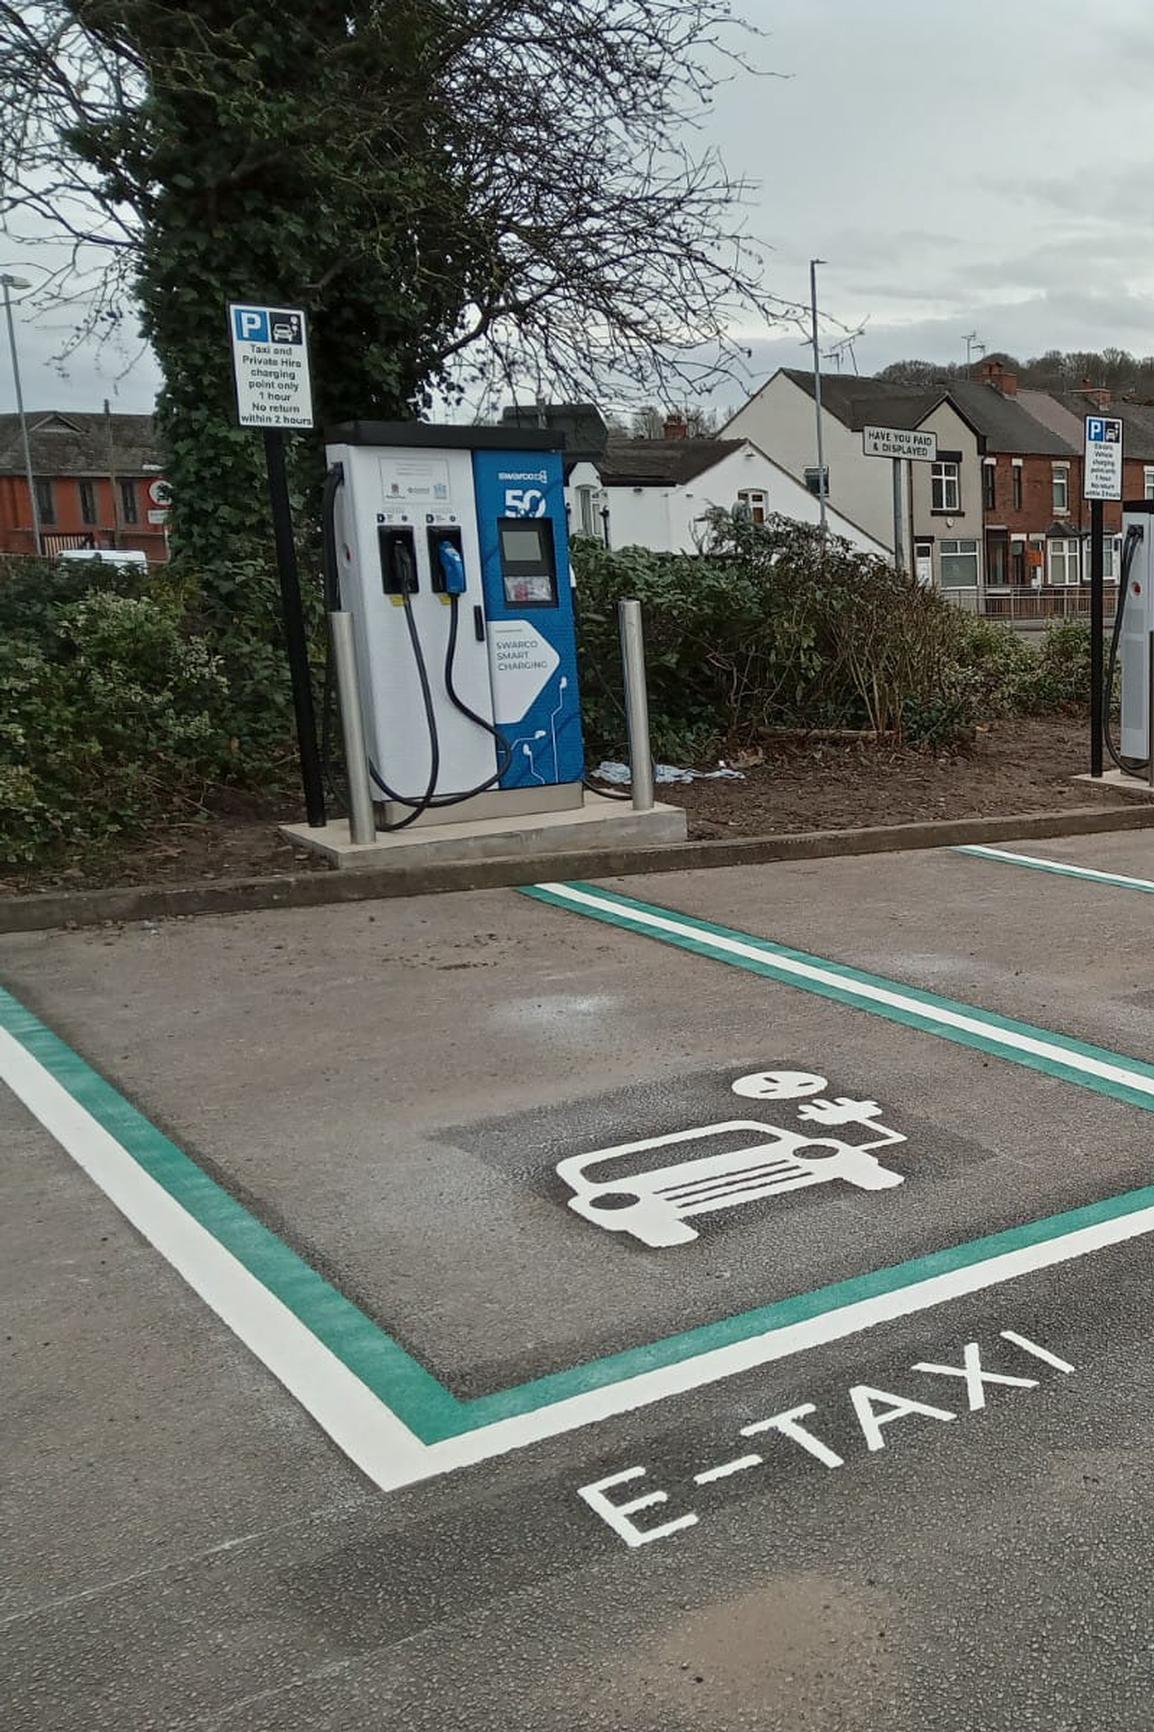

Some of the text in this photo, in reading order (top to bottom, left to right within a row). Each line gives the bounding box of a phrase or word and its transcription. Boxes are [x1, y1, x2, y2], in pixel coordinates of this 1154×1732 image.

[241, 311, 261, 338] P
[250, 344, 292, 356] Taxi and
[242, 355, 302, 368] Private Hire
[250, 368, 296, 381] charging
[248, 380, 299, 393] point only
[259, 391, 292, 402] 1 hour
[252, 403, 300, 413] No return
[241, 414, 312, 426] within 2 hours
[1091, 421, 1101, 440] P
[868, 430, 932, 446] HAVE YOU PAID
[873, 442, 928, 456] & DISPLAYED
[505, 489, 546, 518] 50
[496, 640, 538, 650] SWARCO
[496, 651, 529, 661] SMART
[498, 661, 548, 671] CHARGING
[577, 1330, 1075, 1547] E-TAXI
